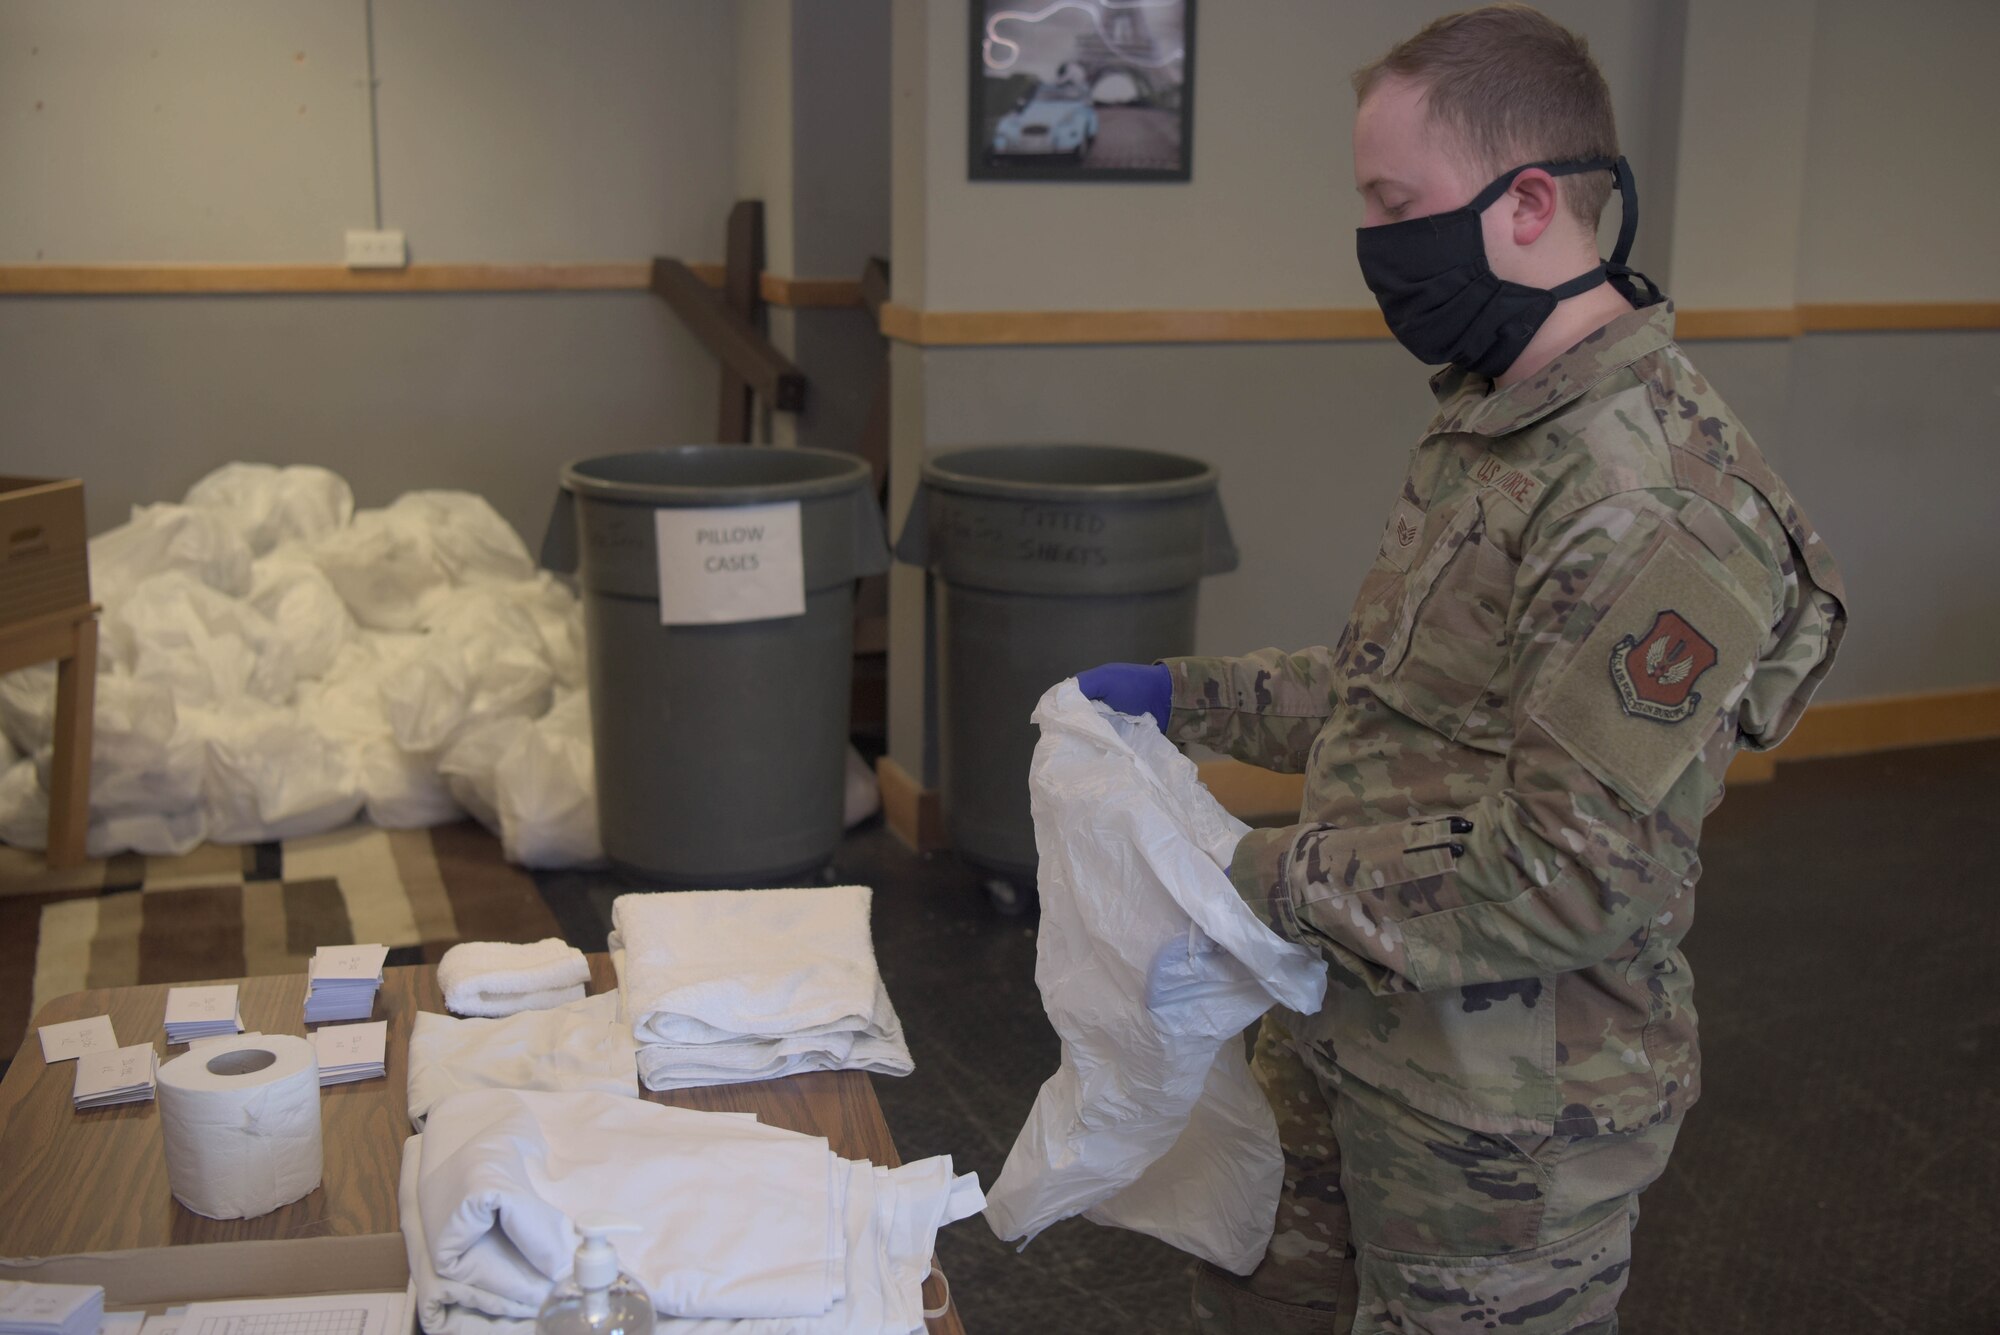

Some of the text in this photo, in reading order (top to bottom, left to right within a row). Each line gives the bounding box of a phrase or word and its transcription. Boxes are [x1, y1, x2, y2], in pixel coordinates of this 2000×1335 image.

[697, 525, 765, 546] PILLOW
[704, 553, 760, 574] CASES
[1654, 705, 1685, 718] EUROPE
